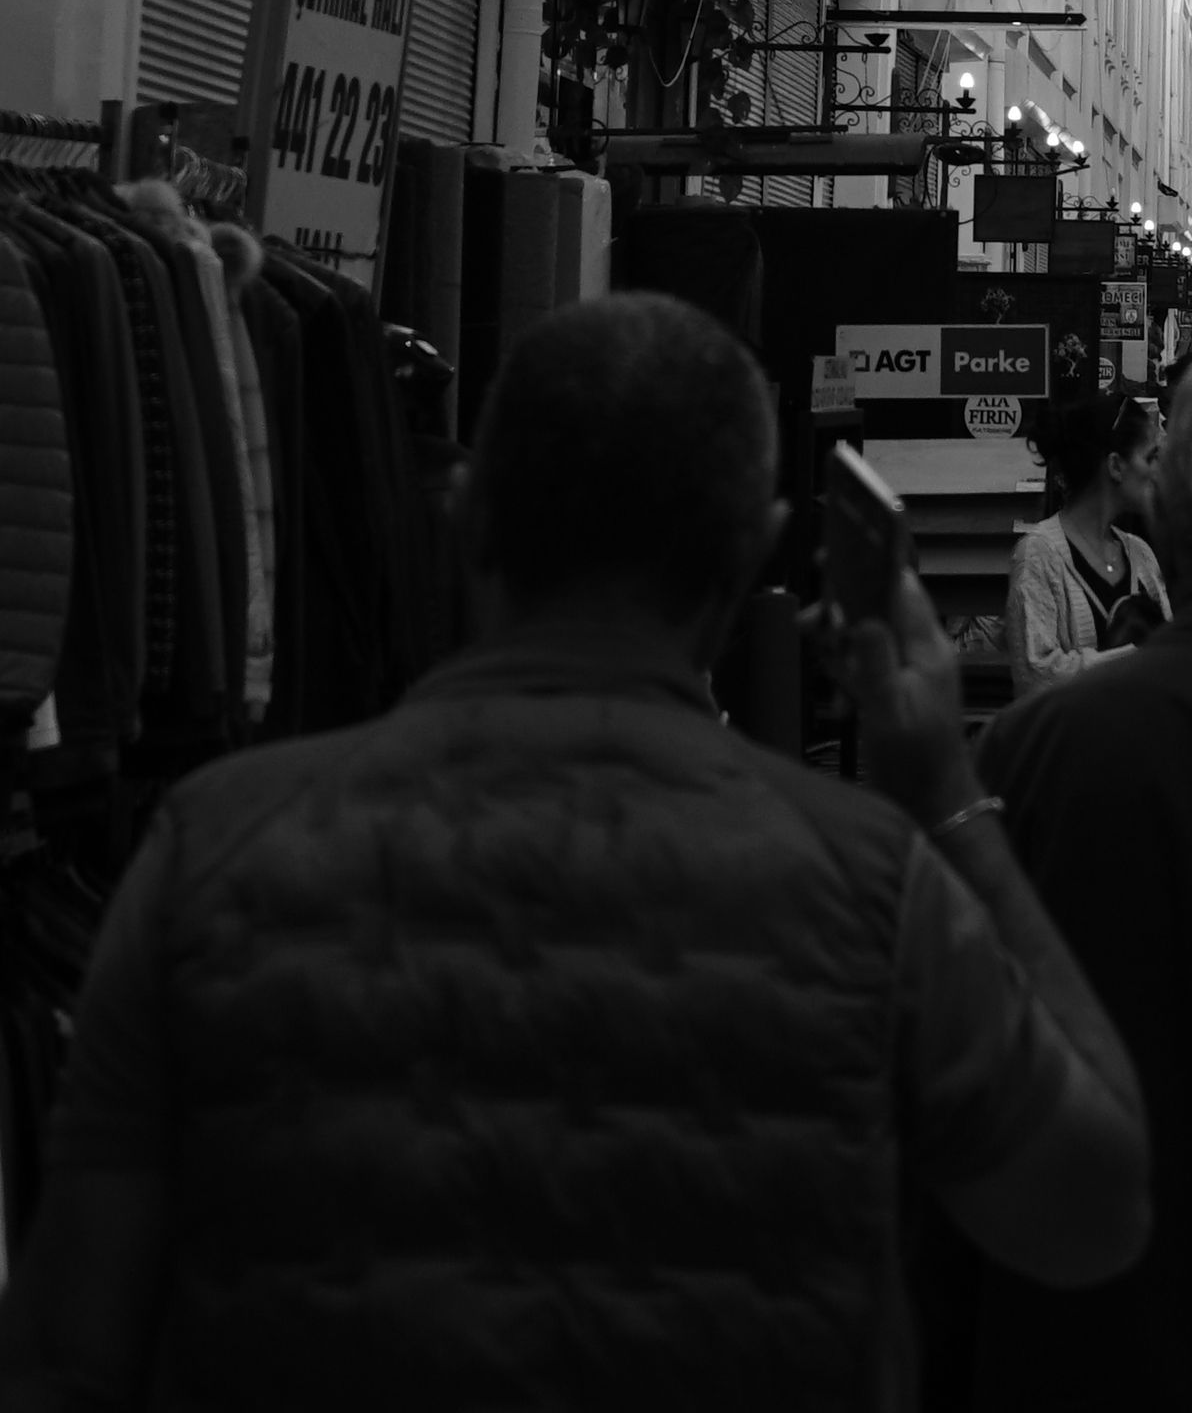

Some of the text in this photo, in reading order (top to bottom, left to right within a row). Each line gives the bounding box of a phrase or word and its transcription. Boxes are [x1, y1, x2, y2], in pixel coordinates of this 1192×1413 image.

[272, 61, 396, 187] 441 22 23
[875, 349, 931, 373] AGT
[953, 349, 1031, 374] Parke
[968, 409, 1017, 425] FIRIN
